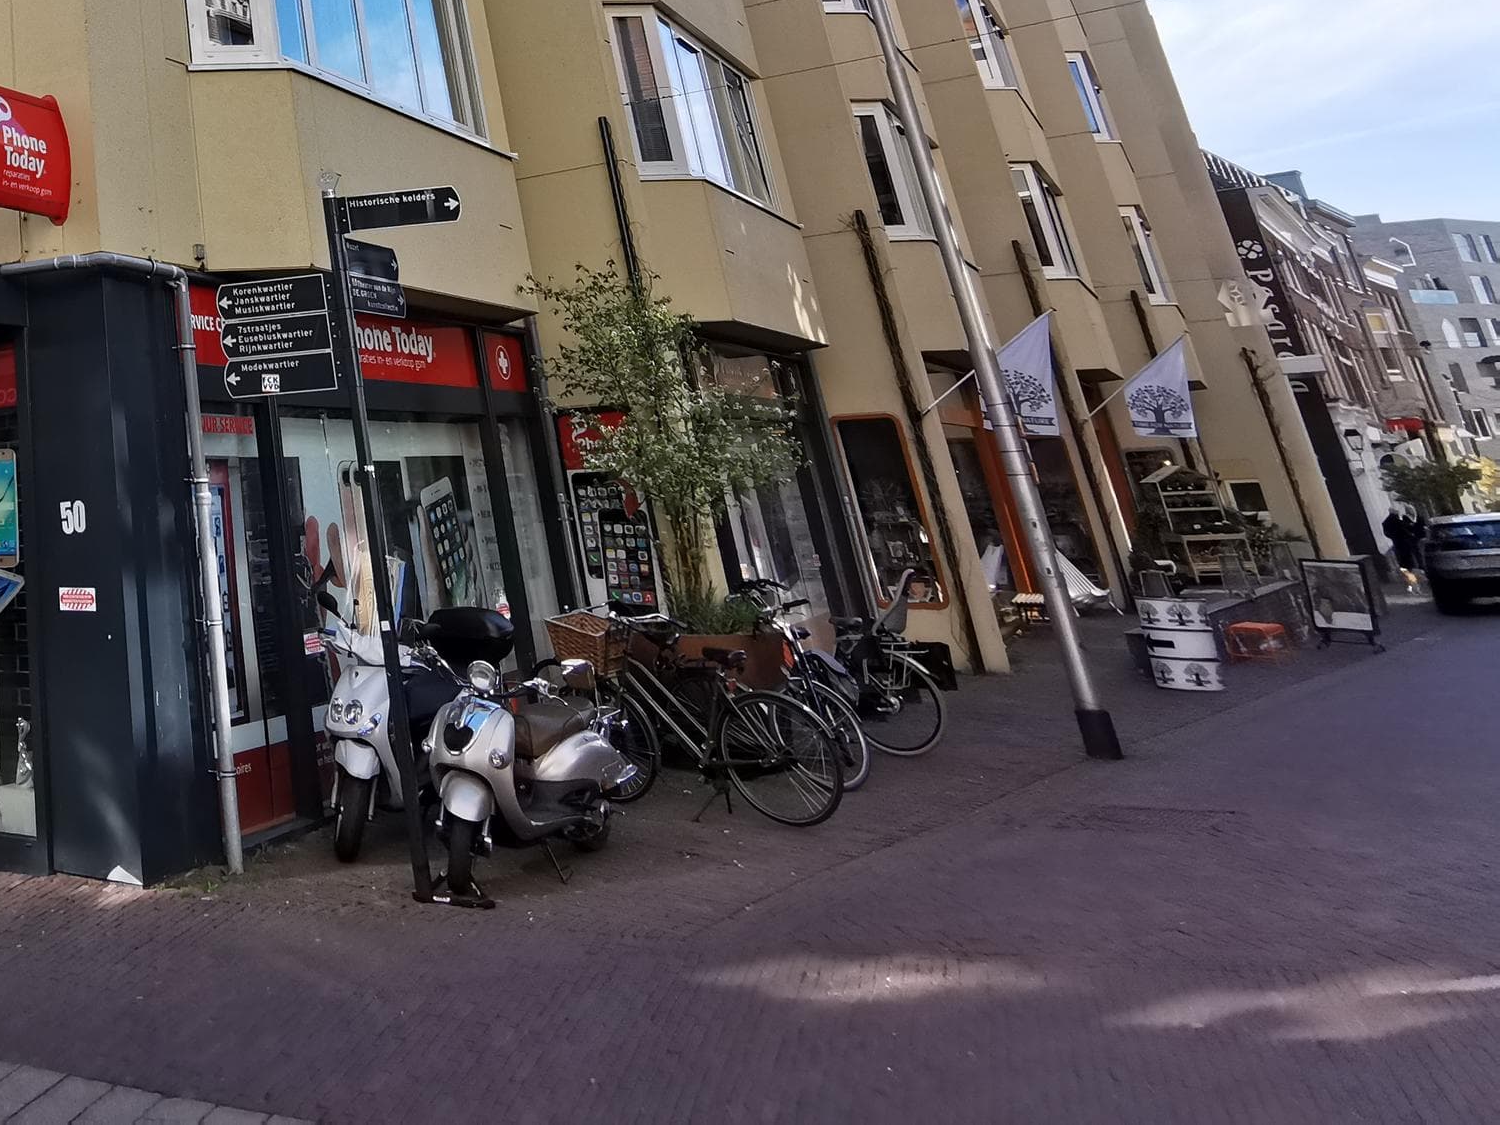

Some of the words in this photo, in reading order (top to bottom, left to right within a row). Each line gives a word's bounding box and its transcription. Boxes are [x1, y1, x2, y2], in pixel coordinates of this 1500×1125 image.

[2, 125, 47, 154] Phone
[4, 145, 45, 179] Today
[349, 195, 400, 208] Historische
[402, 192, 436, 203] kelders
[232, 283, 293, 296] Korenkwartier
[234, 293, 291, 305] Janskwartier
[235, 302, 295, 315] Musiskwartier
[190, 314, 215, 332] RVICE
[237, 323, 281, 335] 7straatjes
[238, 330, 313, 344] Eusebiuskwartier
[239, 341, 293, 354] Rijnkwartier
[355, 326, 392, 353] hone
[391, 326, 433, 363] Today
[241, 360, 300, 372] Modekwartier
[60, 500, 86, 534] 50
